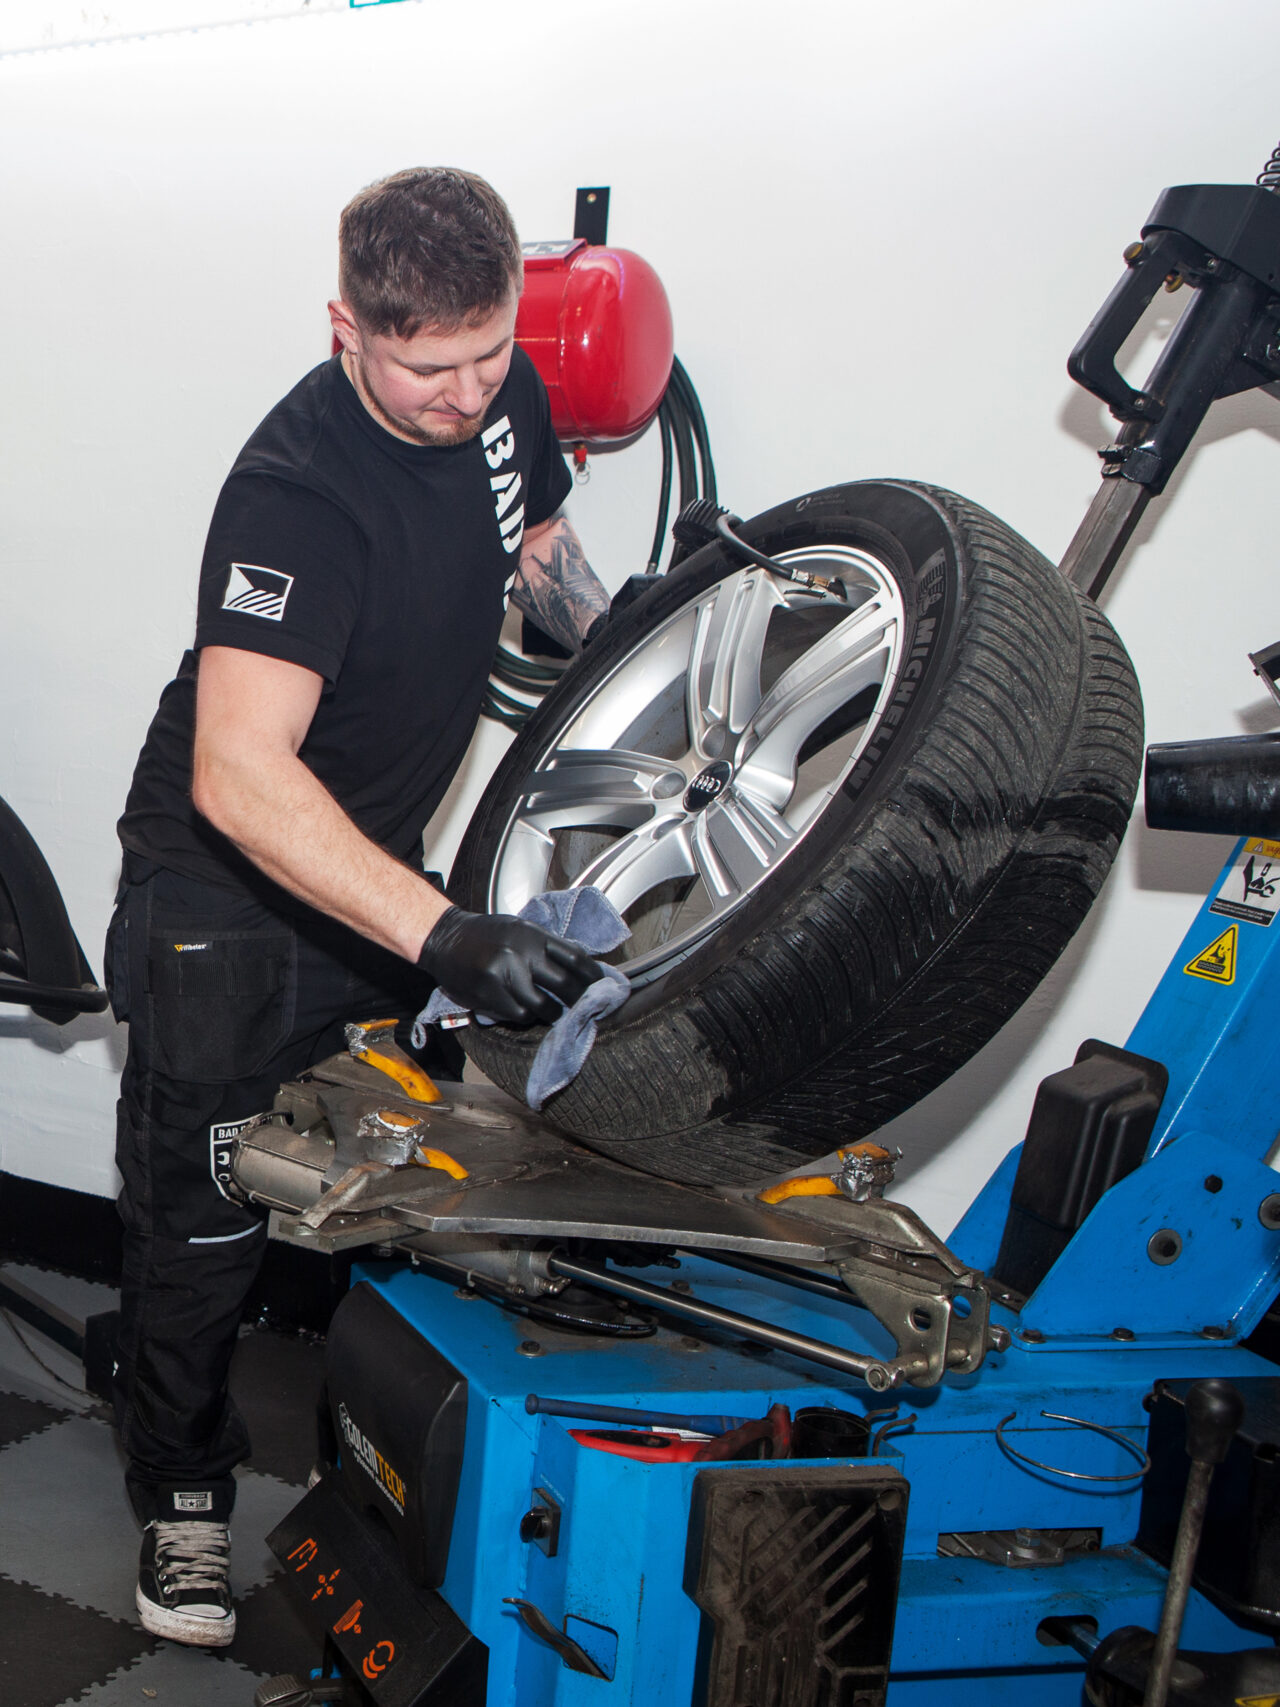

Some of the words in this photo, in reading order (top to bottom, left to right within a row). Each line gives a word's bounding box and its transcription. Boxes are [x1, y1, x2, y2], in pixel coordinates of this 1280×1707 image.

[480, 414, 526, 554] BAD
[847, 616, 937, 791] MICHELIN
[218, 1126, 238, 1139] BAD
